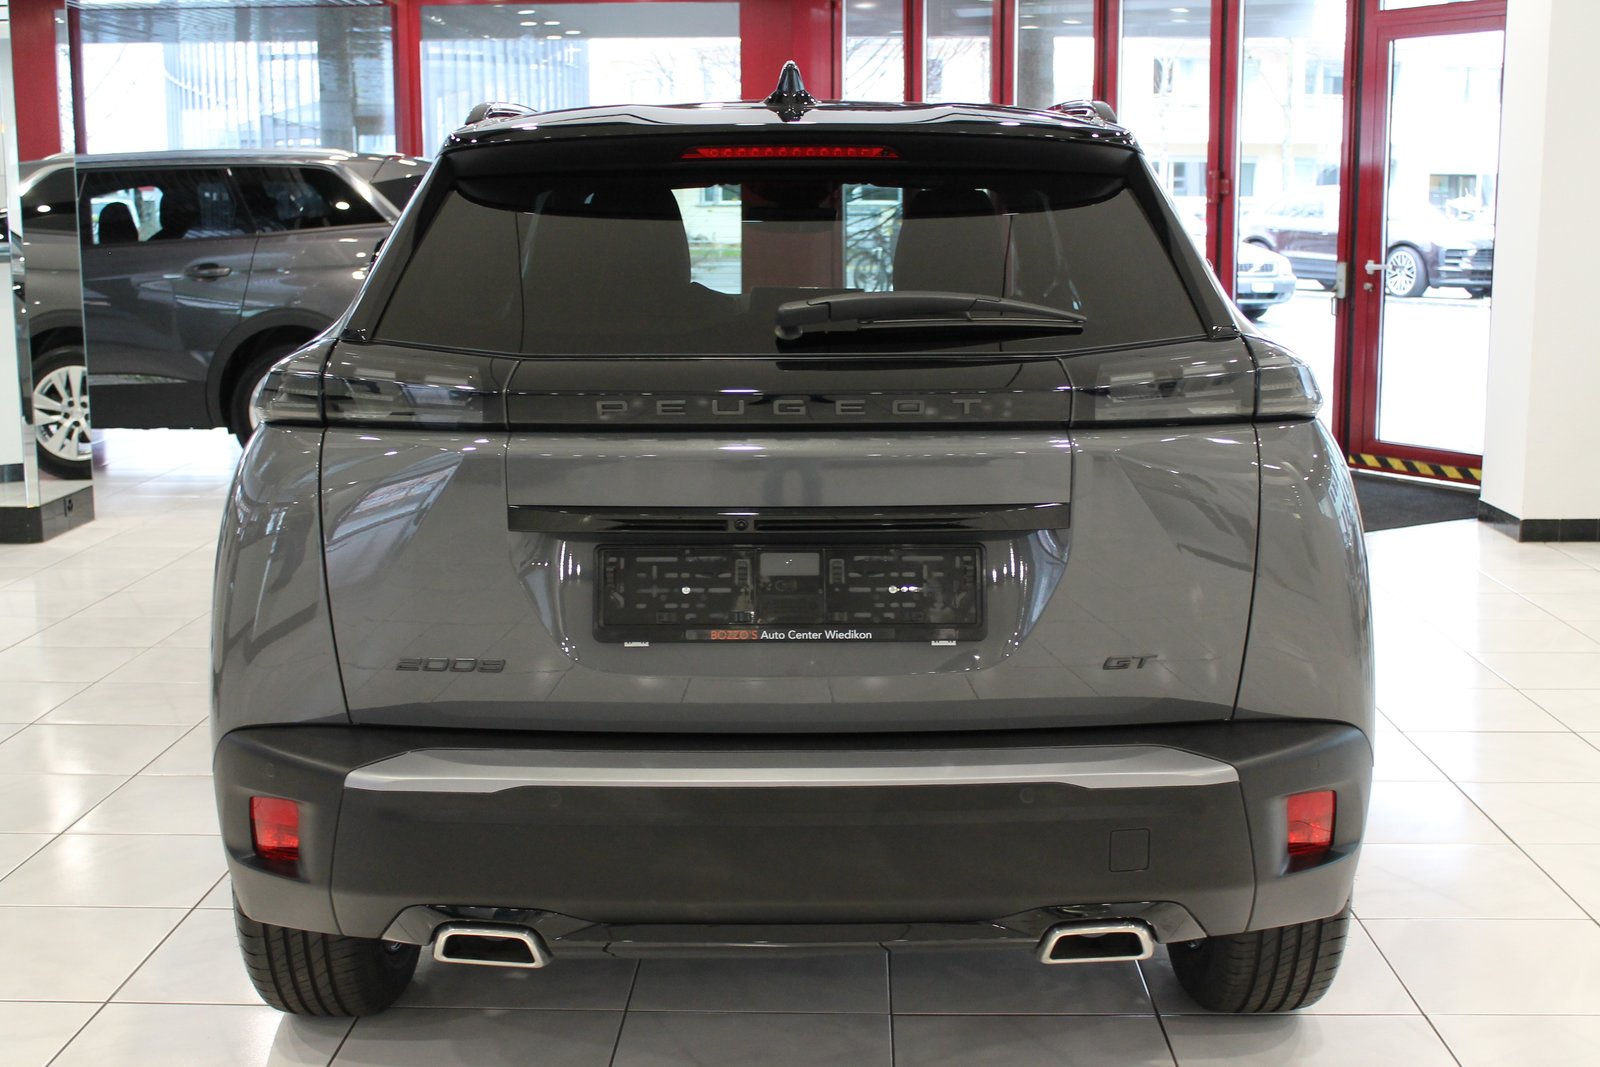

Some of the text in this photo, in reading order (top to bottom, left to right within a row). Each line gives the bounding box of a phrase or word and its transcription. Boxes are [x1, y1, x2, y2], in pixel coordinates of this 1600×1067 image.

[596, 399, 982, 415] PEUGEOT
[760, 630, 785, 640] Auto
[787, 630, 822, 640] Center
[824, 629, 873, 640] Wiedikon
[1102, 654, 1159, 670] GT
